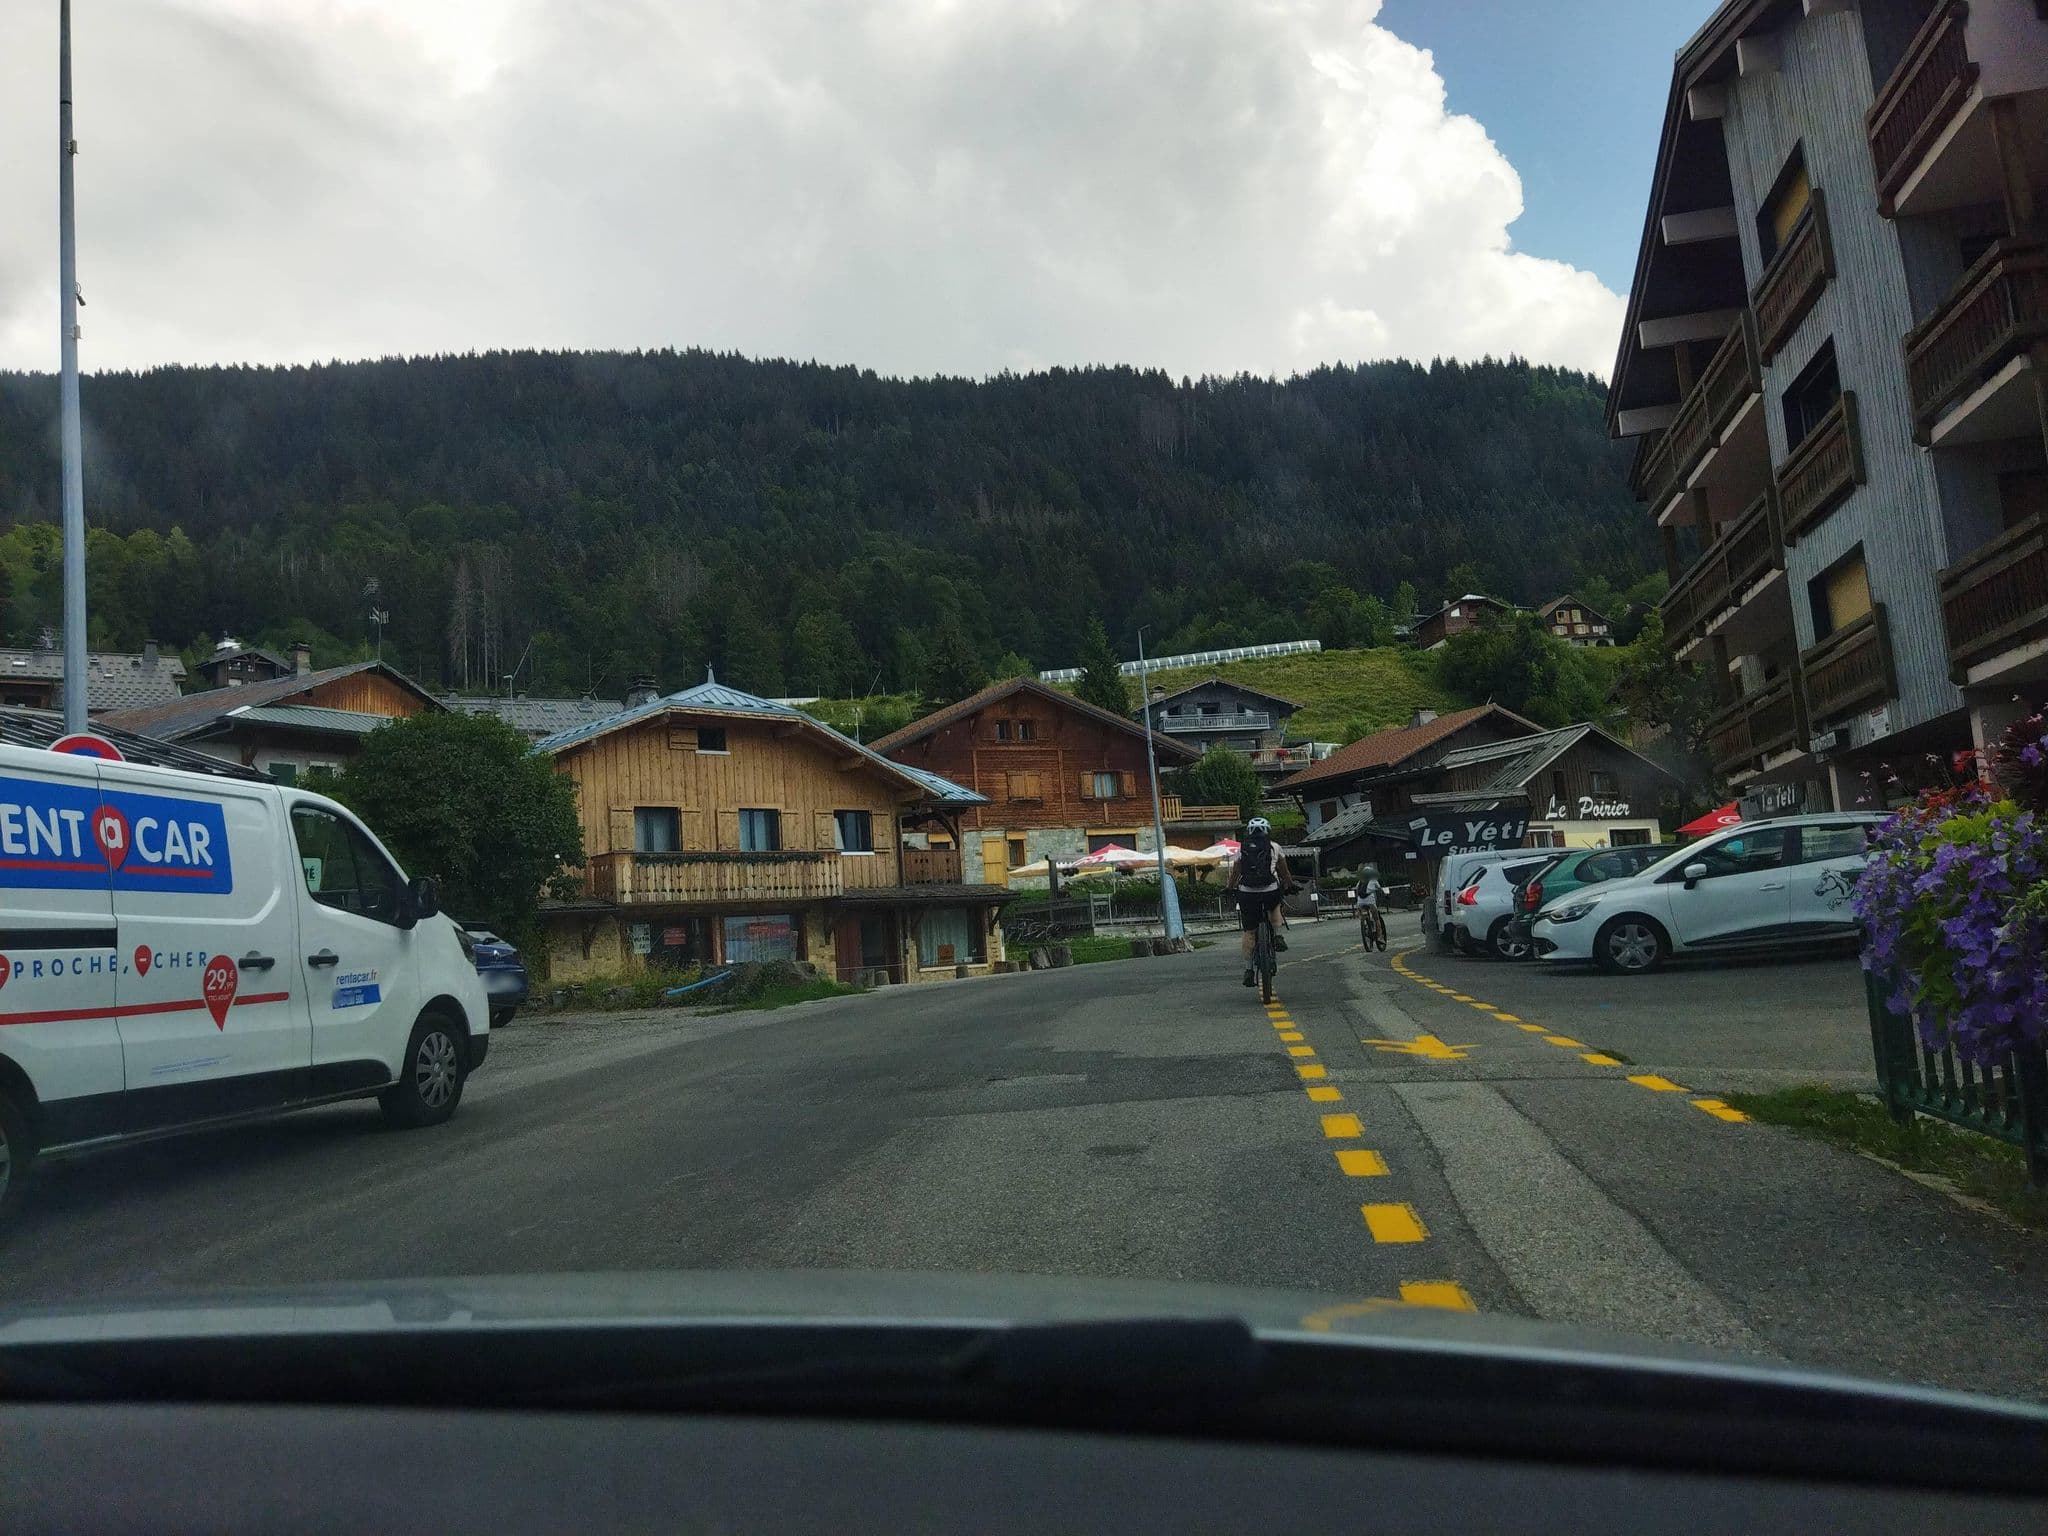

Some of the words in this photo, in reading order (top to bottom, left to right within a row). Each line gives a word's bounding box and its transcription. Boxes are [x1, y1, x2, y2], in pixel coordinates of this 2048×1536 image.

[1546, 793, 1567, 820] Le
[1578, 796, 1630, 820] Poirier
[100, 817, 124, 849] a
[135, 816, 214, 866] CAR
[1420, 827, 1454, 846] Le
[1464, 819, 1525, 843] Yéti
[1448, 842, 1497, 857] Snack
[154, 951, 207, 969] CHER
[336, 968, 377, 985] rentacar.fr
